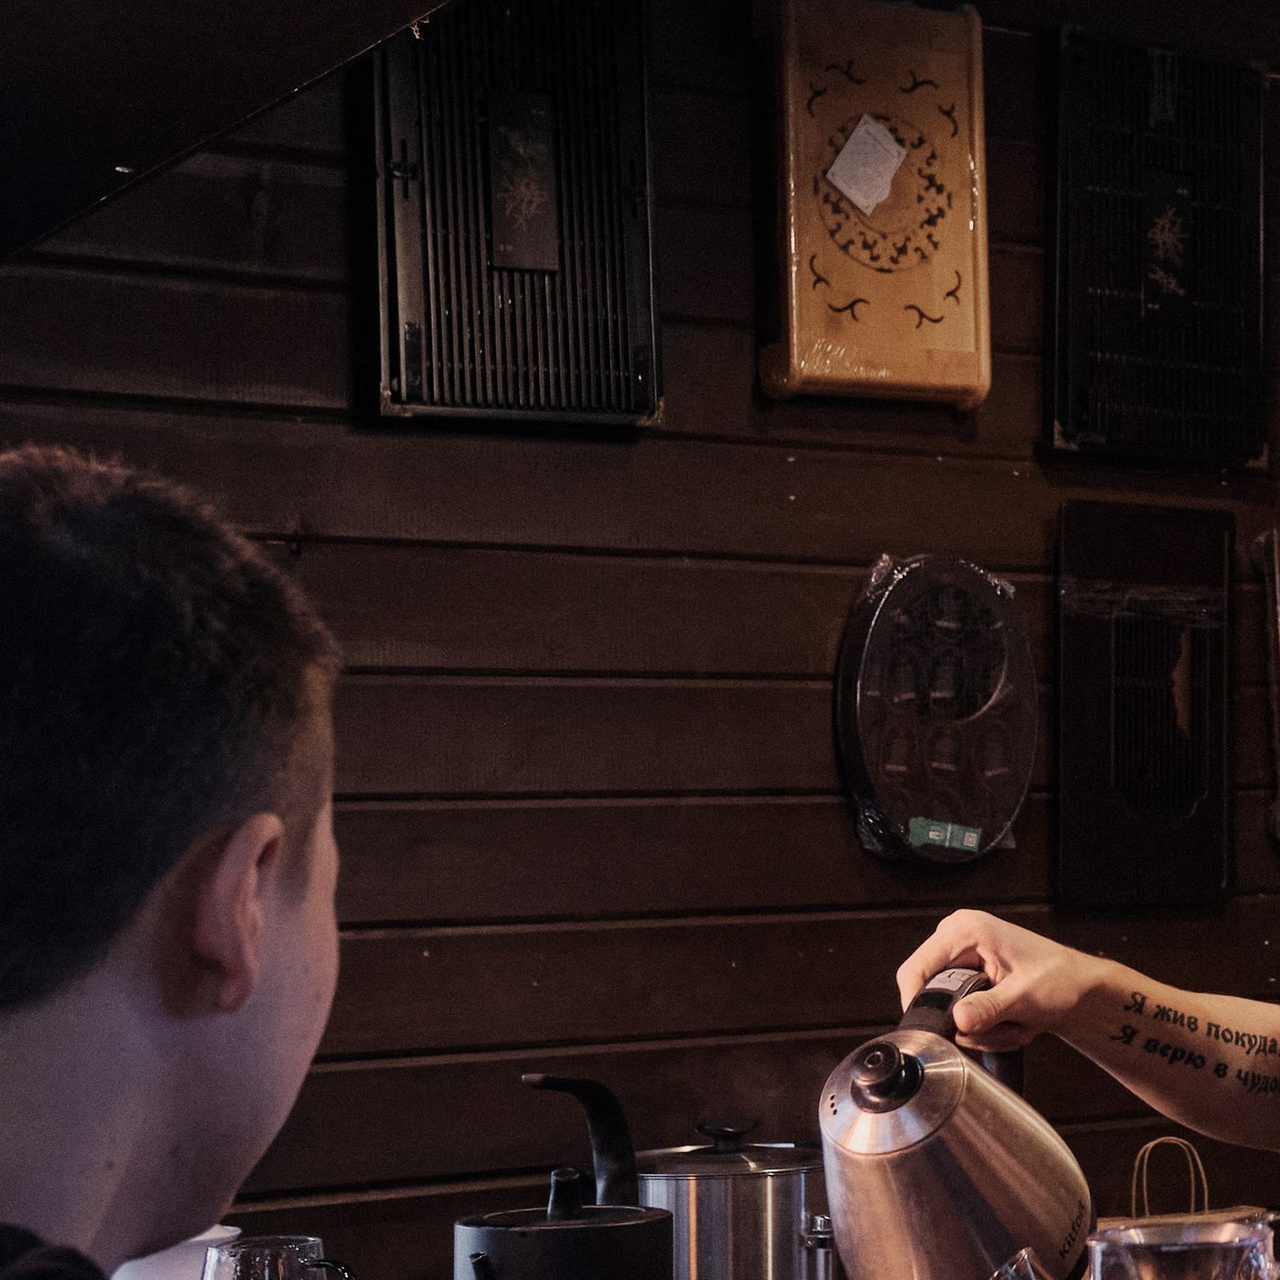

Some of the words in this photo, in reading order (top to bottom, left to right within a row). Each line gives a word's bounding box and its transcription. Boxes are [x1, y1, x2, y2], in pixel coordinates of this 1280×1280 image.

[1123, 991, 1148, 1015] Я
[1153, 1004, 1199, 1033] жив
[1110, 1024, 1139, 1047] Я
[1144, 1037, 1206, 1069] верю
[1214, 1062, 1229, 1079] в
[1059, 1200, 1085, 1259] Kitfort
